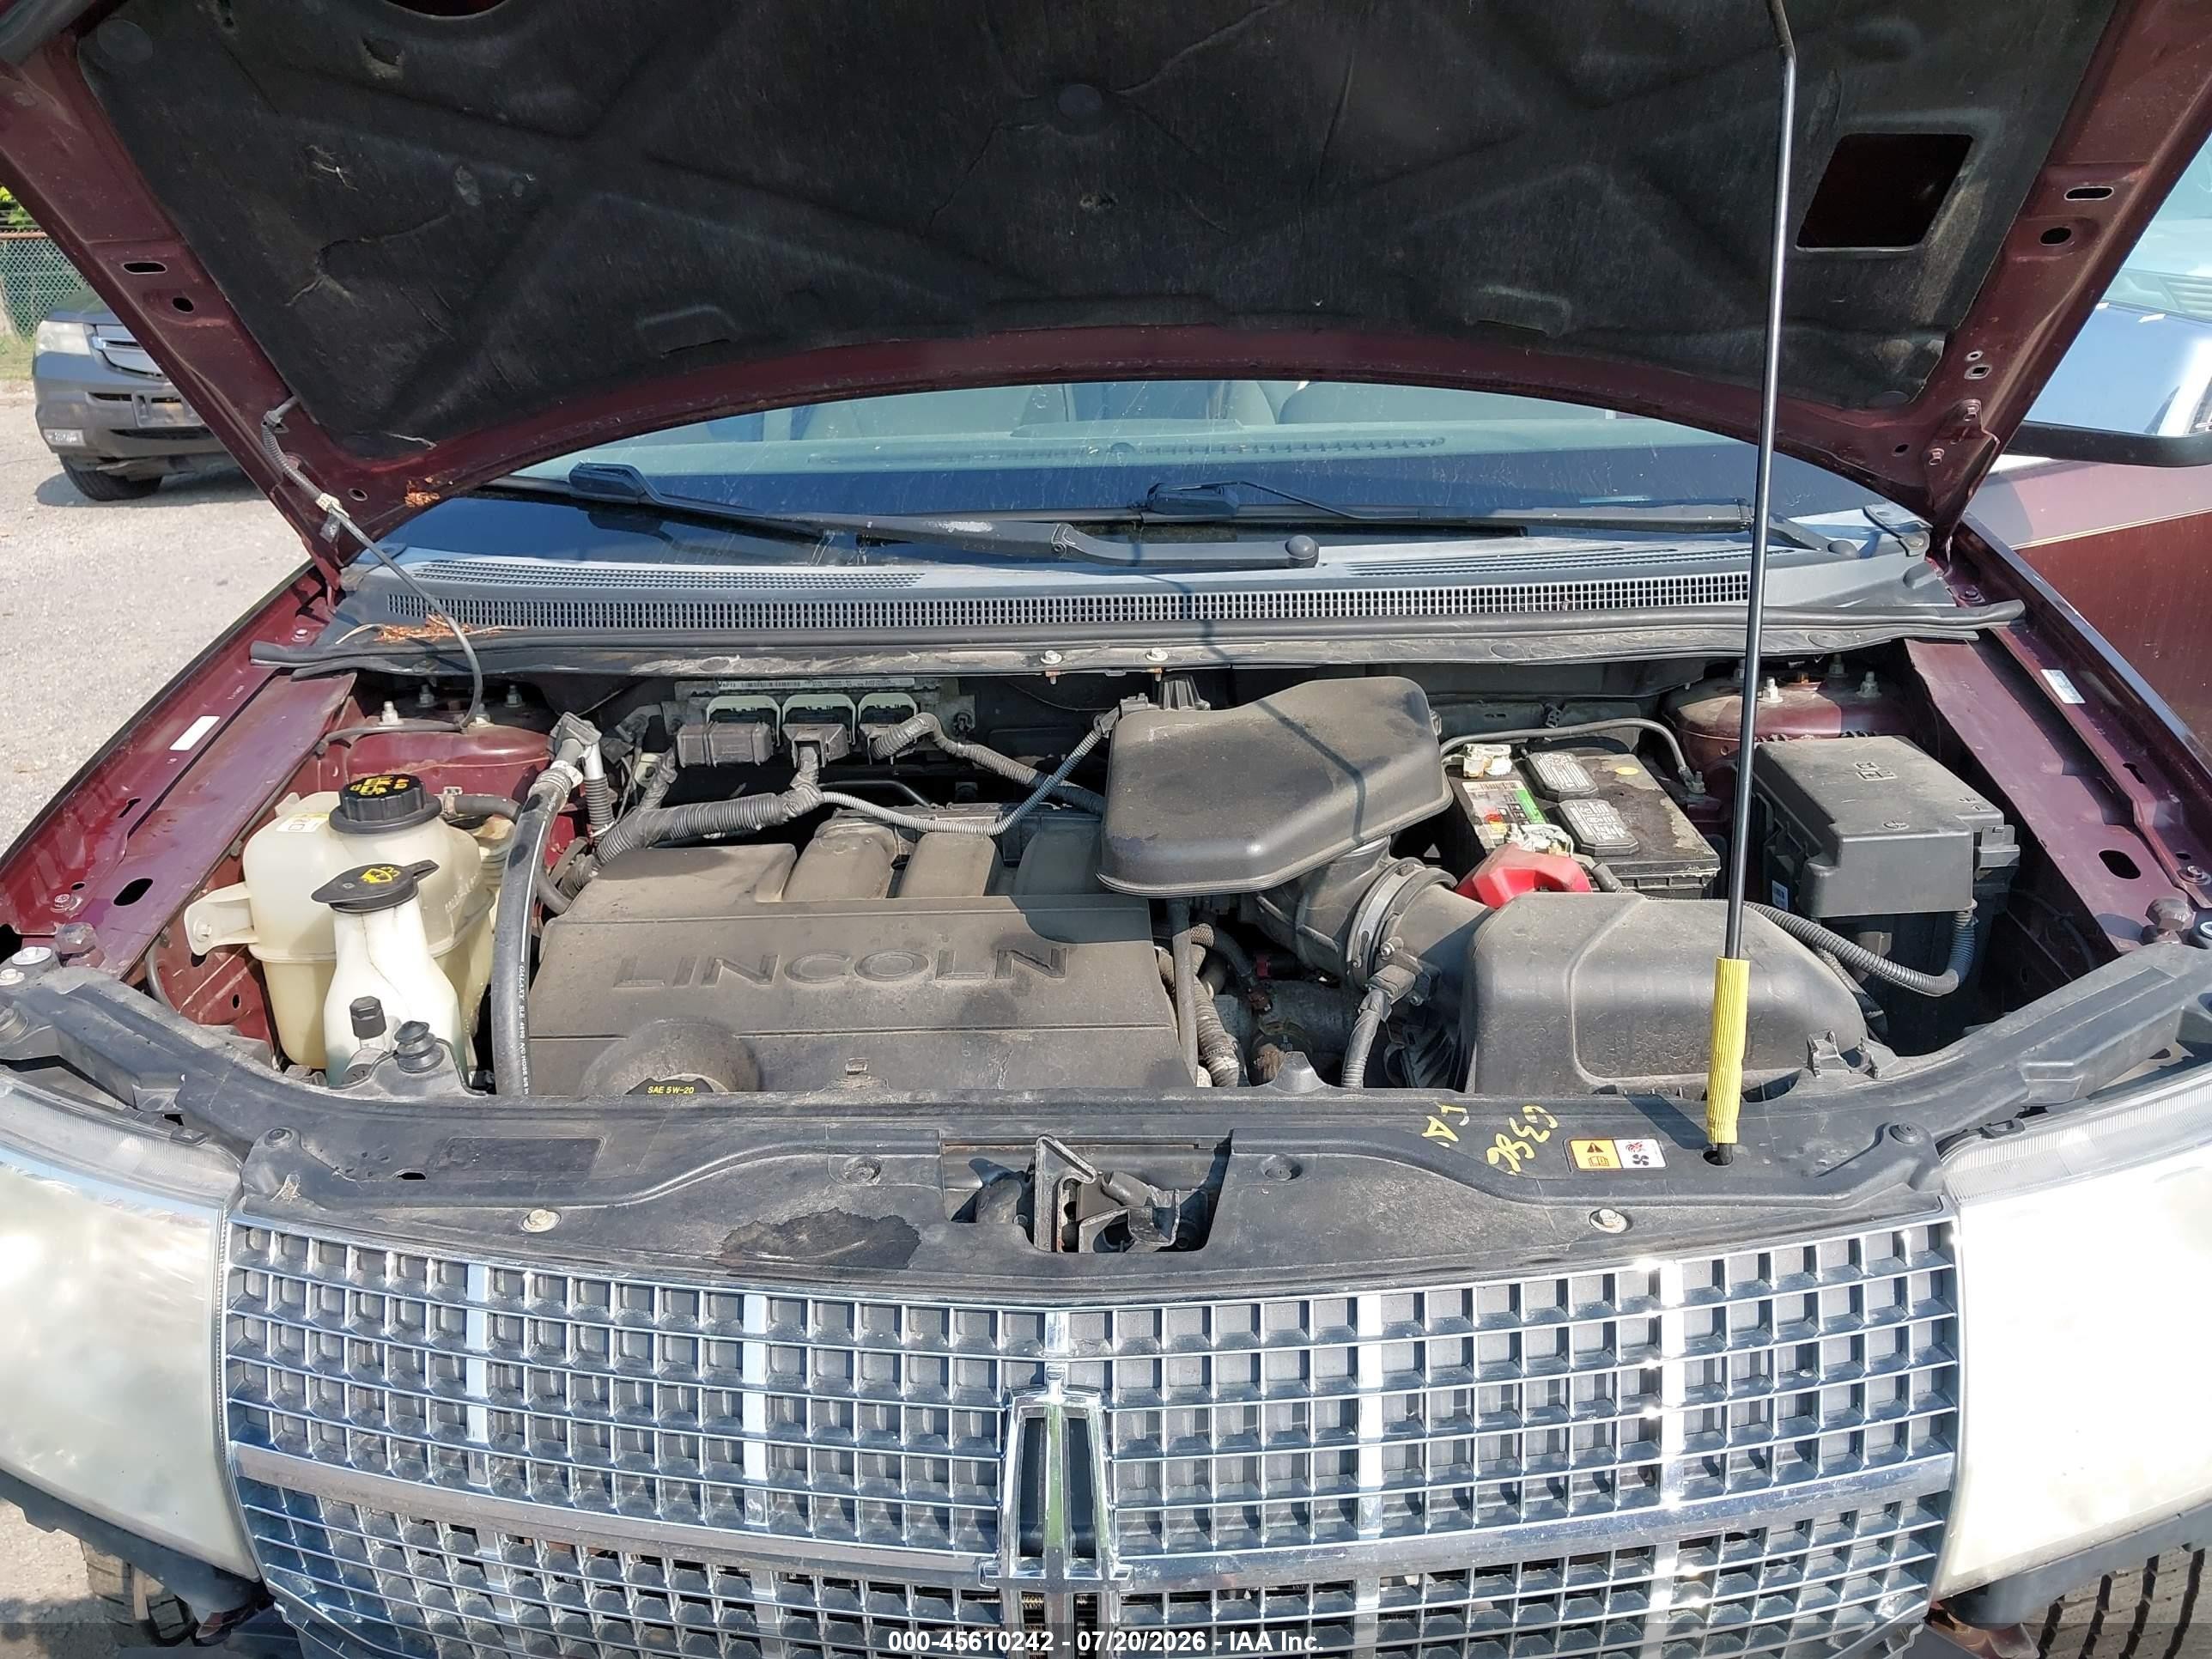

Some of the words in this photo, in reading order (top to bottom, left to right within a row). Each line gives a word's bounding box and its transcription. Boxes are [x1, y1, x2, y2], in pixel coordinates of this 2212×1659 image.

[612, 947, 1069, 988] LINCOLN
[647, 1085, 665, 1094] SAE
[665, 1085, 695, 1094] 5W-20
